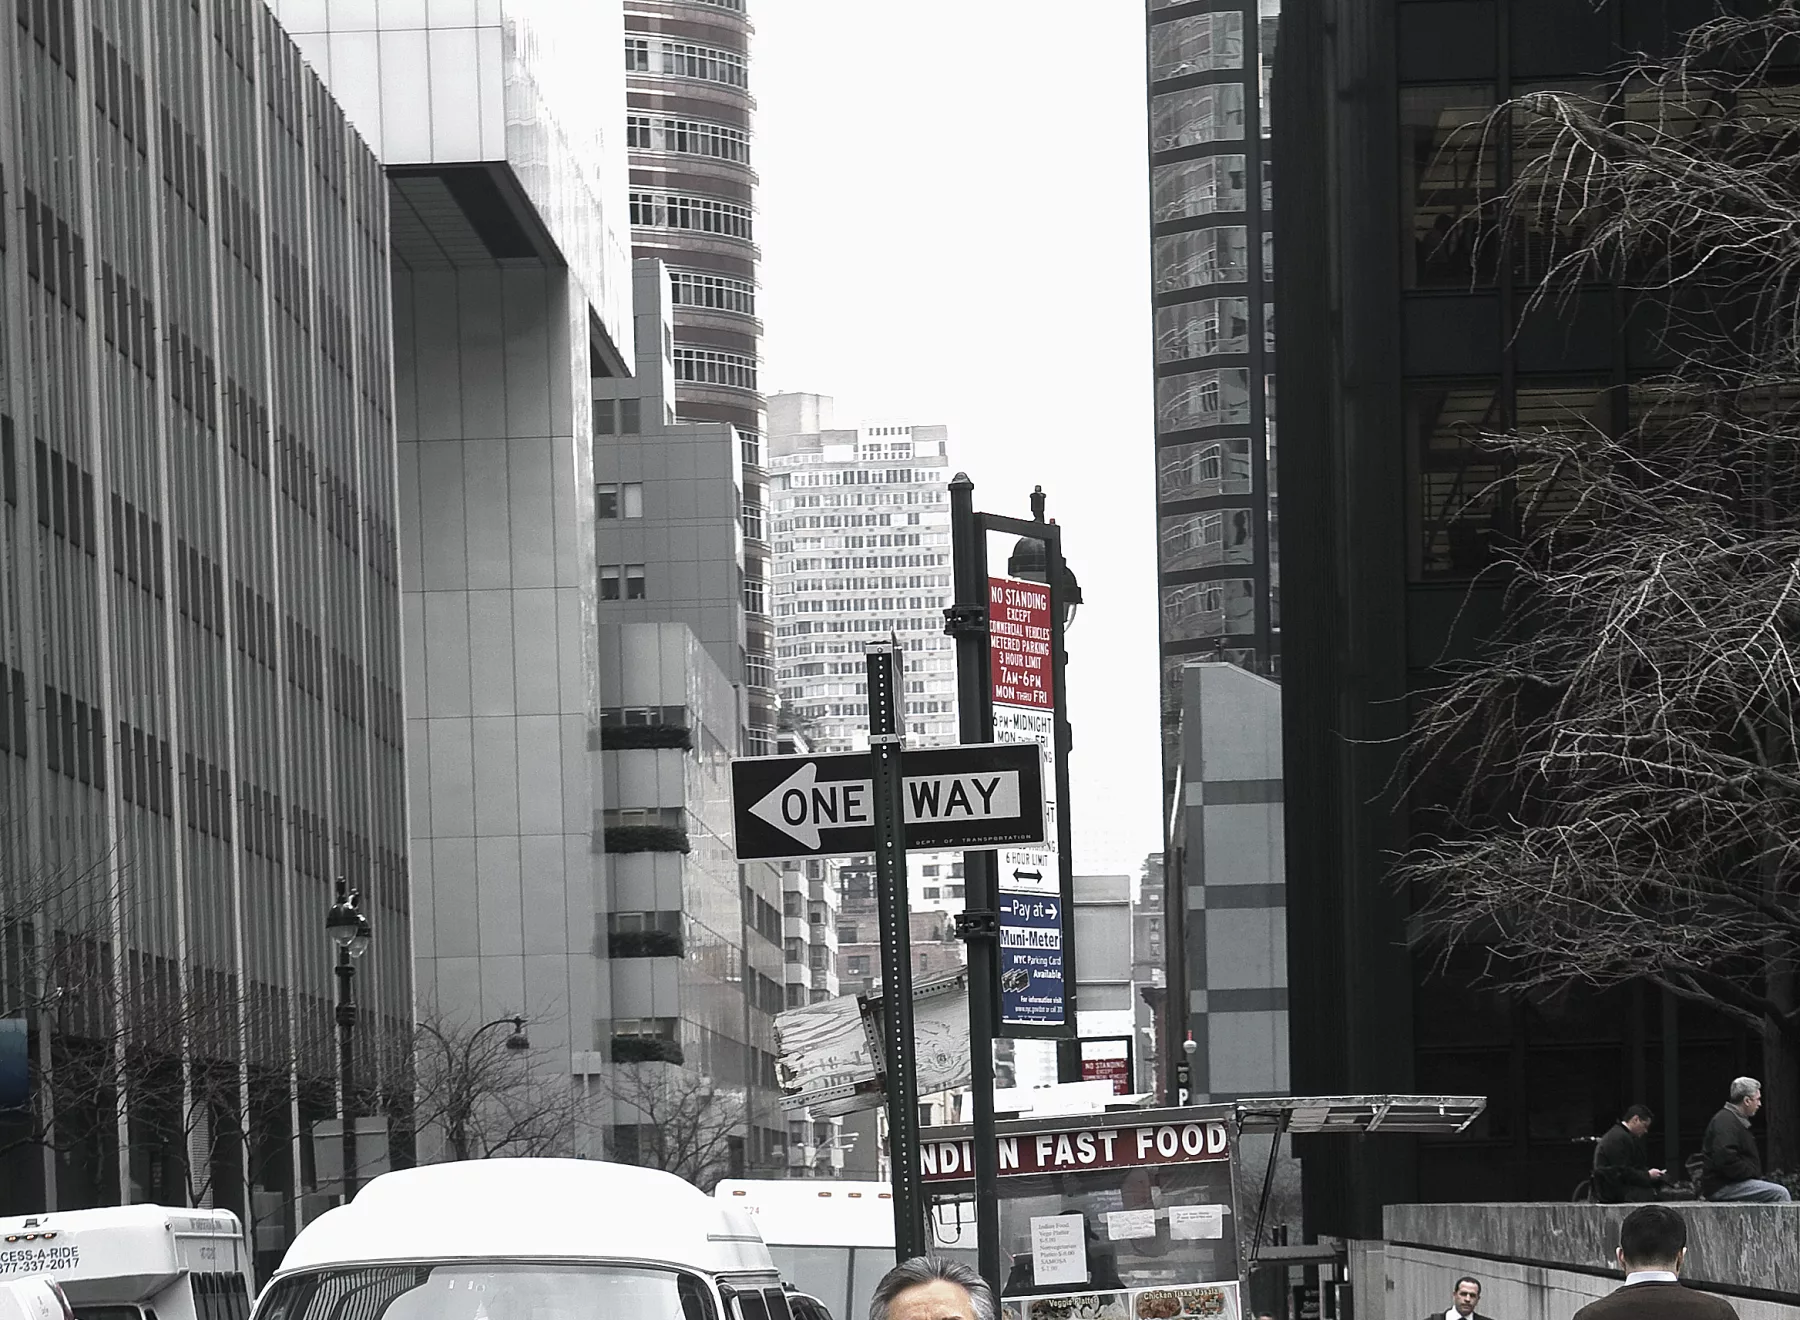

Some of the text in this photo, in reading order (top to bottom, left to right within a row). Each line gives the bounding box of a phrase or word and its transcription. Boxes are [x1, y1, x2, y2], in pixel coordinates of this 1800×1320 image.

[991, 586, 1047, 611] NO STANDING
[1006, 607, 1031, 623] EXCEPT
[989, 620, 1050, 641] COMMERCIAL VEHICLES
[990, 635, 1049, 656] METERED PARKING
[999, 651, 1042, 669] 3 HOUR LIMIT
[1000, 666, 1042, 688] 7AM-6PM
[995, 685, 1047, 704] MON THRU FRI
[997, 730, 1016, 742] MON
[781, 784, 867, 826] ONE
[910, 777, 1002, 818] WAY
[962, 834, 1031, 843] TRANSPORTATION
[1012, 852, 1030, 865] HOUR
[1032, 853, 1048, 866] LIMIT
[1012, 899, 1044, 921] Pay at
[1000, 929, 1059, 948] Muni-Meter
[1014, 955, 1061, 967] NYC Parking Card
[1033, 969, 1062, 979] Available
[1028, 995, 1052, 1003] information
[1095, 1061, 1125, 1069] STANDING
[920, 1123, 1227, 1175] NDIN FAST FOOD
[1049, 1298, 1073, 1308] Veggie
[1143, 1292, 1172, 1300] Chicken
[1173, 1290, 1193, 1299] Tikka
